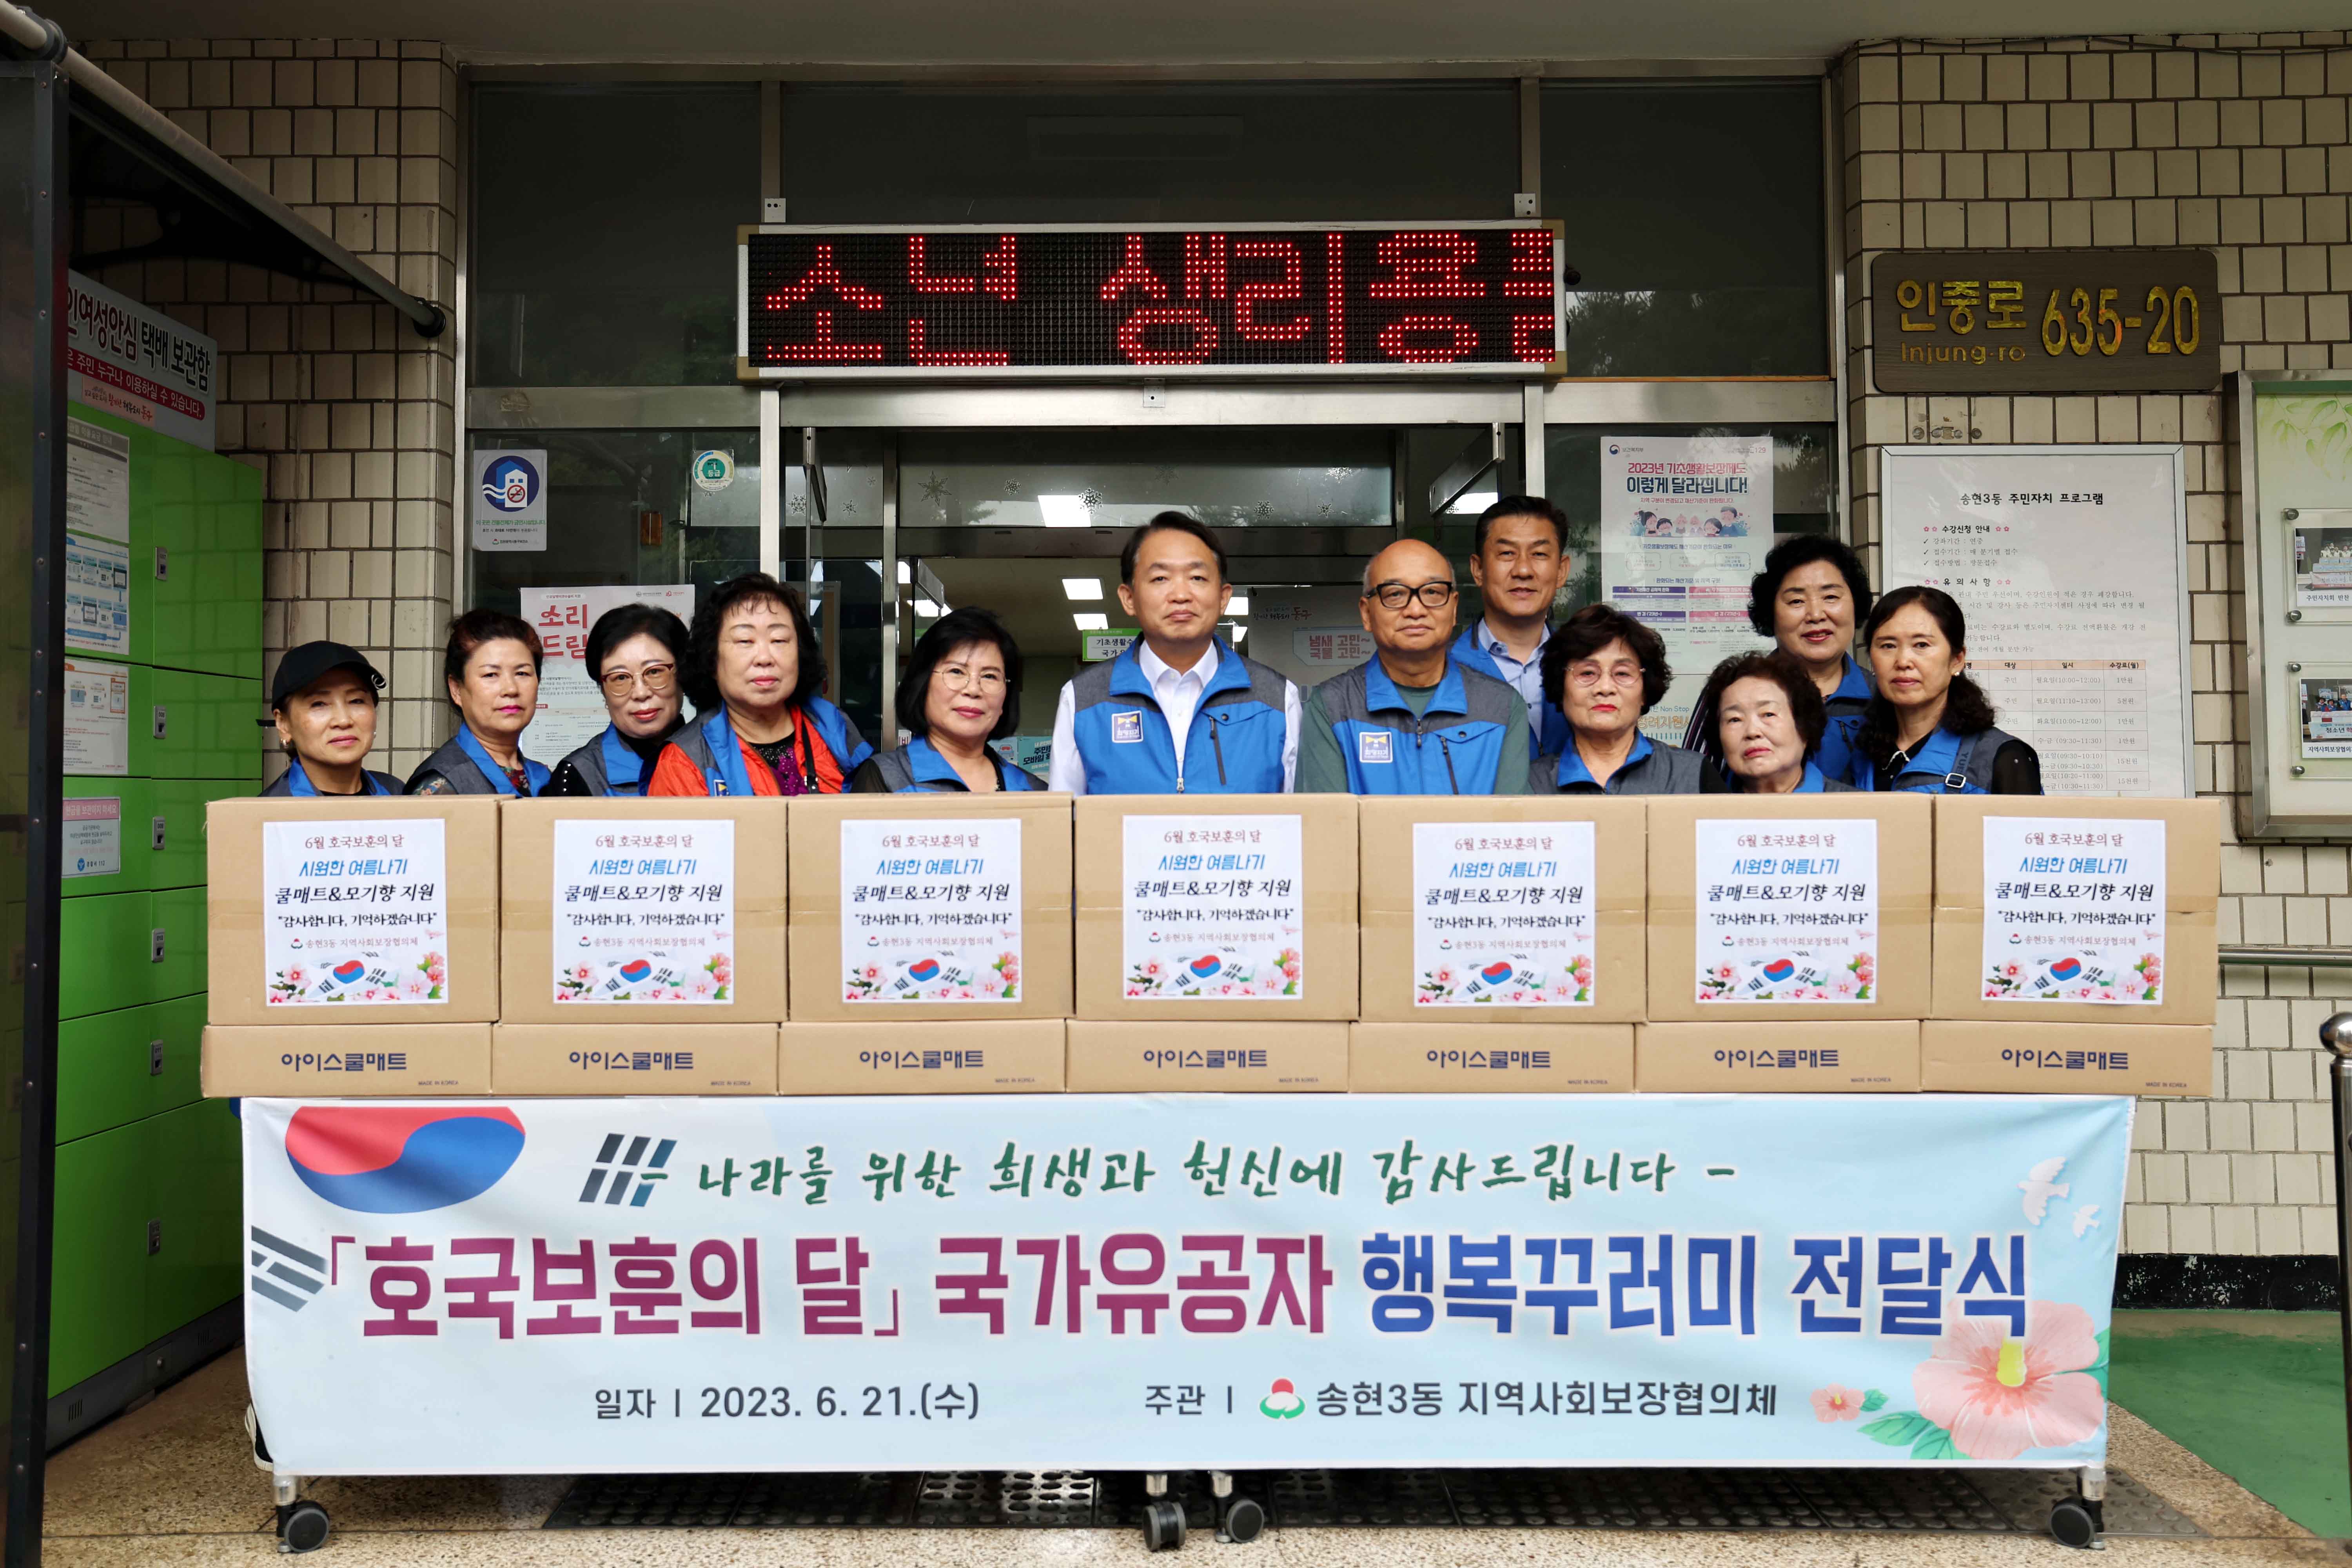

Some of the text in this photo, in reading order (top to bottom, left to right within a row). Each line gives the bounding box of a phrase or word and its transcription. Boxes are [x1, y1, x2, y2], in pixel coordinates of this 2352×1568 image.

[1896, 279, 2200, 356] 인중로 635-20
[142, 321, 168, 368] 택배
[172, 336, 210, 392] 보관함
[76, 357, 202, 418] 주민 누구나 이용하실 수 있습니다.
[1628, 463, 1746, 474] 2023년 기초생활보장제도
[1627, 477, 1747, 494] 이렇게 달라집니다!
[1960, 493, 2103, 506] 송현3동 주민자치 프로그램
[1942, 525, 1971, 534] 수강신청
[539, 604, 588, 629] 소리
[543, 634, 587, 660] 드림
[1310, 635, 1332, 647] 냄새
[305, 835, 404, 849] 6월 호국보훈의 달
[596, 835, 693, 848] 6월 호국보훈의 달
[882, 834, 979, 848] 6월 호국보훈의 달
[1164, 830, 1261, 843] 6월 호국보훈의 달
[1455, 837, 1552, 851] 6월 호국보훈의 달
[1738, 834, 1836, 847] 6월 호국보훈의 달
[2025, 832, 2123, 847] 6월 호국보훈의 달
[299, 859, 407, 876] 시원한 여름나기
[590, 859, 696, 875] 시원한 여름나기
[877, 859, 984, 875] 시원한 여름나기
[1159, 855, 1265, 870] 시원한 여름나기
[1450, 862, 1557, 878] 시원한 여름나기
[1732, 859, 1839, 874] 시원한 여름나기
[2020, 857, 2127, 874] 시원한 여름나기
[276, 884, 434, 904] 쿨매트&모기향 지원
[565, 884, 722, 902] 쿨매트&모기향 지원
[853, 884, 1009, 902] 쿨매트&모기향 지원
[1135, 879, 1290, 897] 쿨매트&모기향 지원
[1426, 886, 1583, 905] 쿨매트&모기향 지원
[1708, 884, 1865, 901] 쿨매트&모기향 지원
[1996, 882, 2153, 901] 쿨매트&모기향 지원
[306, 937, 418, 948] 송현3동 지역사회보장협의체
[1164, 933, 1274, 942] 송현3동 지역사회보장협의체
[1737, 937, 1848, 946] 송현3동 지역사회보장협의체
[281, 1053, 407, 1072] 아이스쿨매트
[569, 1052, 693, 1070] 아이스쿨매트
[860, 1051, 983, 1069] 아이스쿨매트
[1144, 1050, 1267, 1068] 아이스쿨매트
[1427, 1051, 1550, 1069] 아이스쿨매트
[1715, 1050, 1838, 1068] 아이스쿨매트
[2002, 1049, 2128, 1070] 아이스쿨매트
[699, 1140, 1675, 1205] 나라를 위한 희생과 헌신에 감사드립니다
[936, 1234, 1333, 1334] 국가유공자
[1362, 1233, 1755, 1336] 행복꾸러미
[1791, 1236, 2025, 1338] 전달식
[595, 1381, 1776, 1419] 일자 2023. 6. 21.(수) 주관 송현3동 지역사회보장협의체
